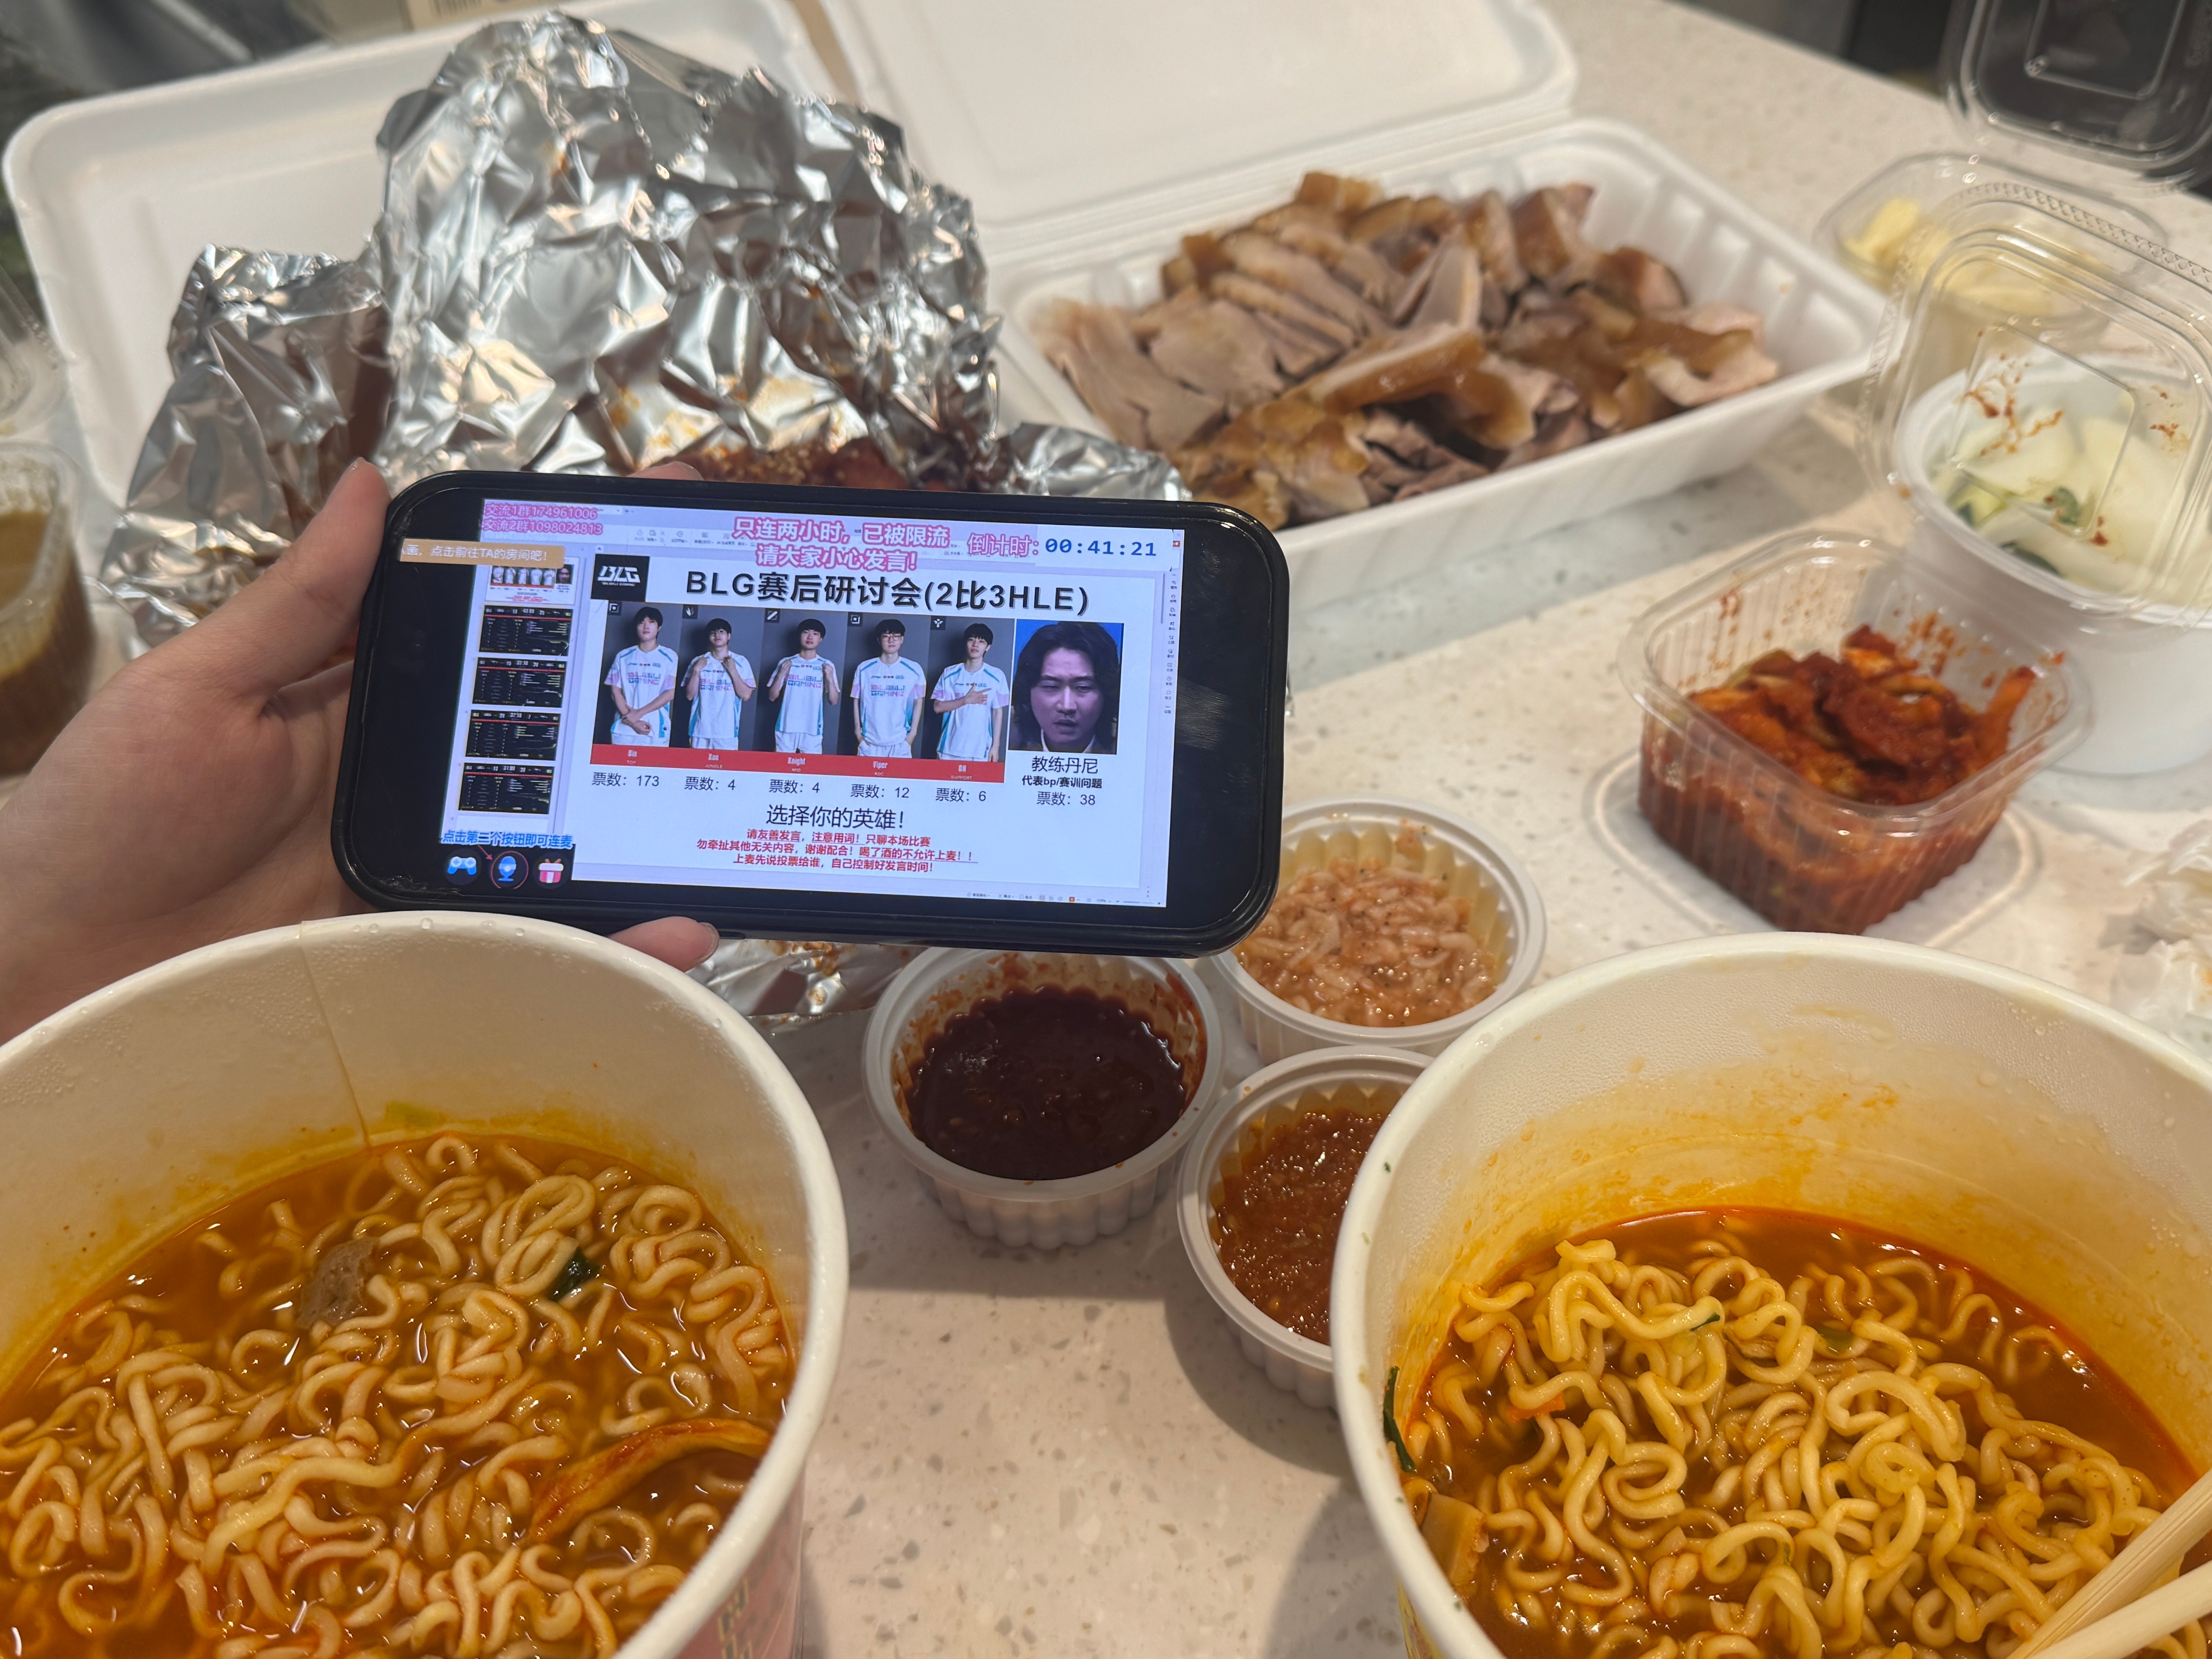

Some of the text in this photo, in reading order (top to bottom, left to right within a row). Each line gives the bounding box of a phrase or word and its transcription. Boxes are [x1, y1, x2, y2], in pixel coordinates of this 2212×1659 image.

[484, 503, 598, 519] 交流1群174961006
[482, 518, 603, 535] 交流2群1098024813
[732, 517, 950, 548] 只连两小时，已被限流
[1046, 538, 1157, 556] 00:41:21
[597, 566, 641, 583] BLG
[788, 756, 806, 766] Knight
[873, 761, 888, 769] Viper
[1032, 756, 1099, 774] 教练丹尼
[1022, 775, 1103, 789] 代表bp/赛训问题
